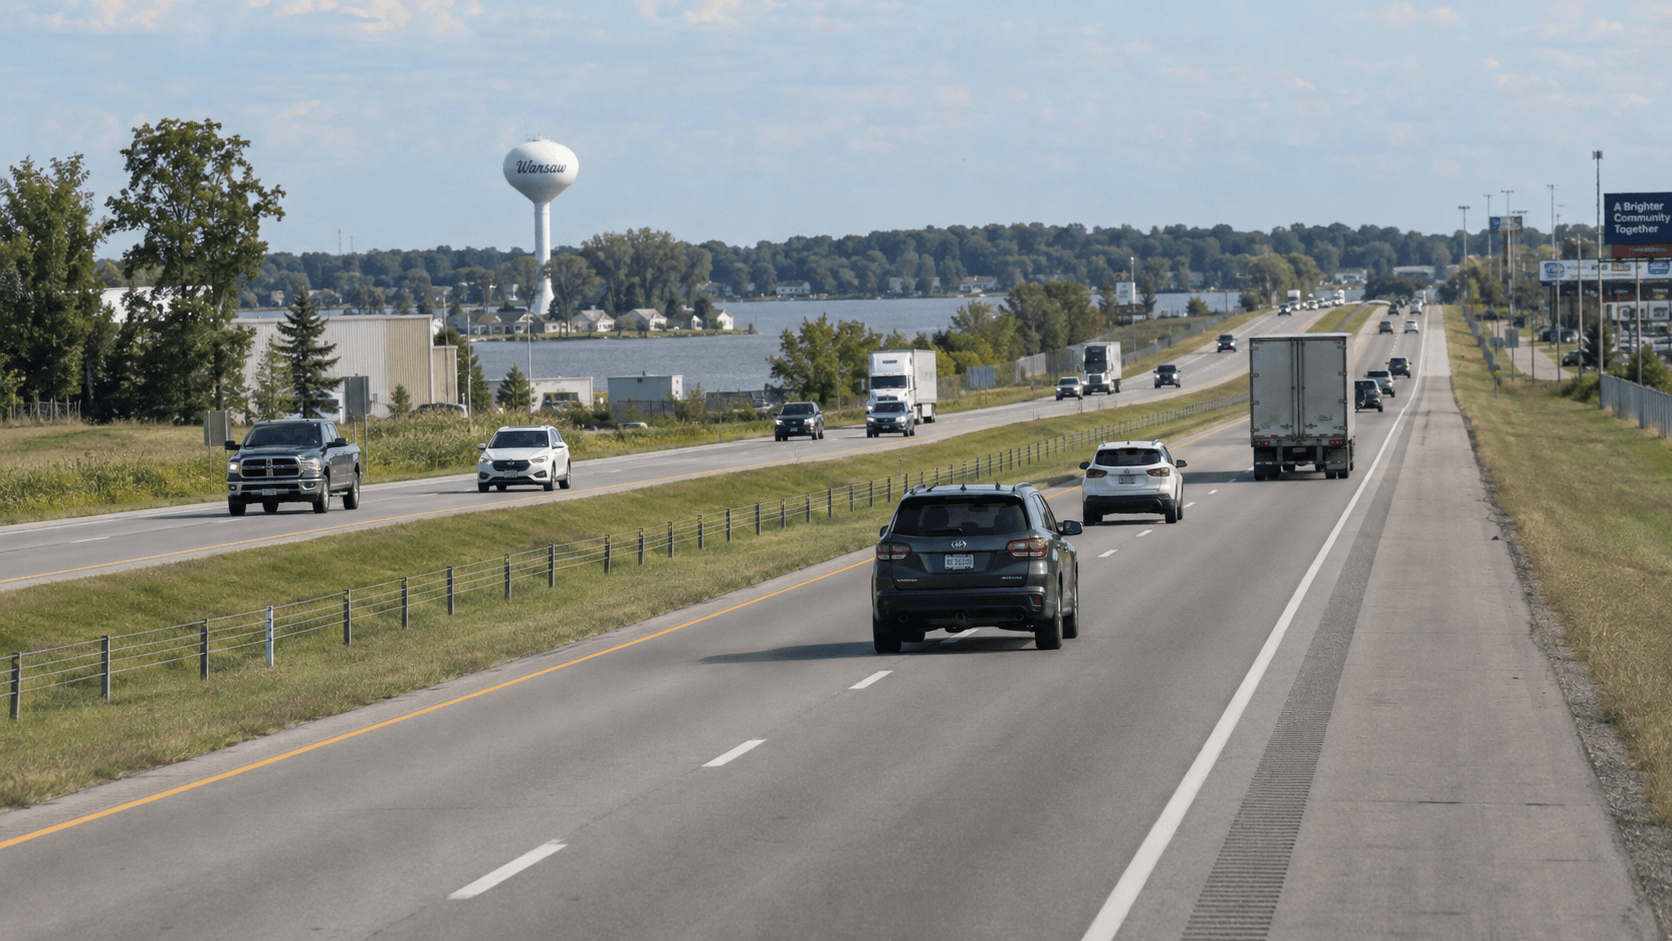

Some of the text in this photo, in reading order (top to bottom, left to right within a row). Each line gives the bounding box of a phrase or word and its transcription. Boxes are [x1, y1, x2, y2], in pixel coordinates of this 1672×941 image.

[516, 160, 566, 174] Warsaw
[1614, 201, 1664, 213] A Brighter
[1614, 212, 1670, 224] Community
[1614, 224, 1659, 236] Together
